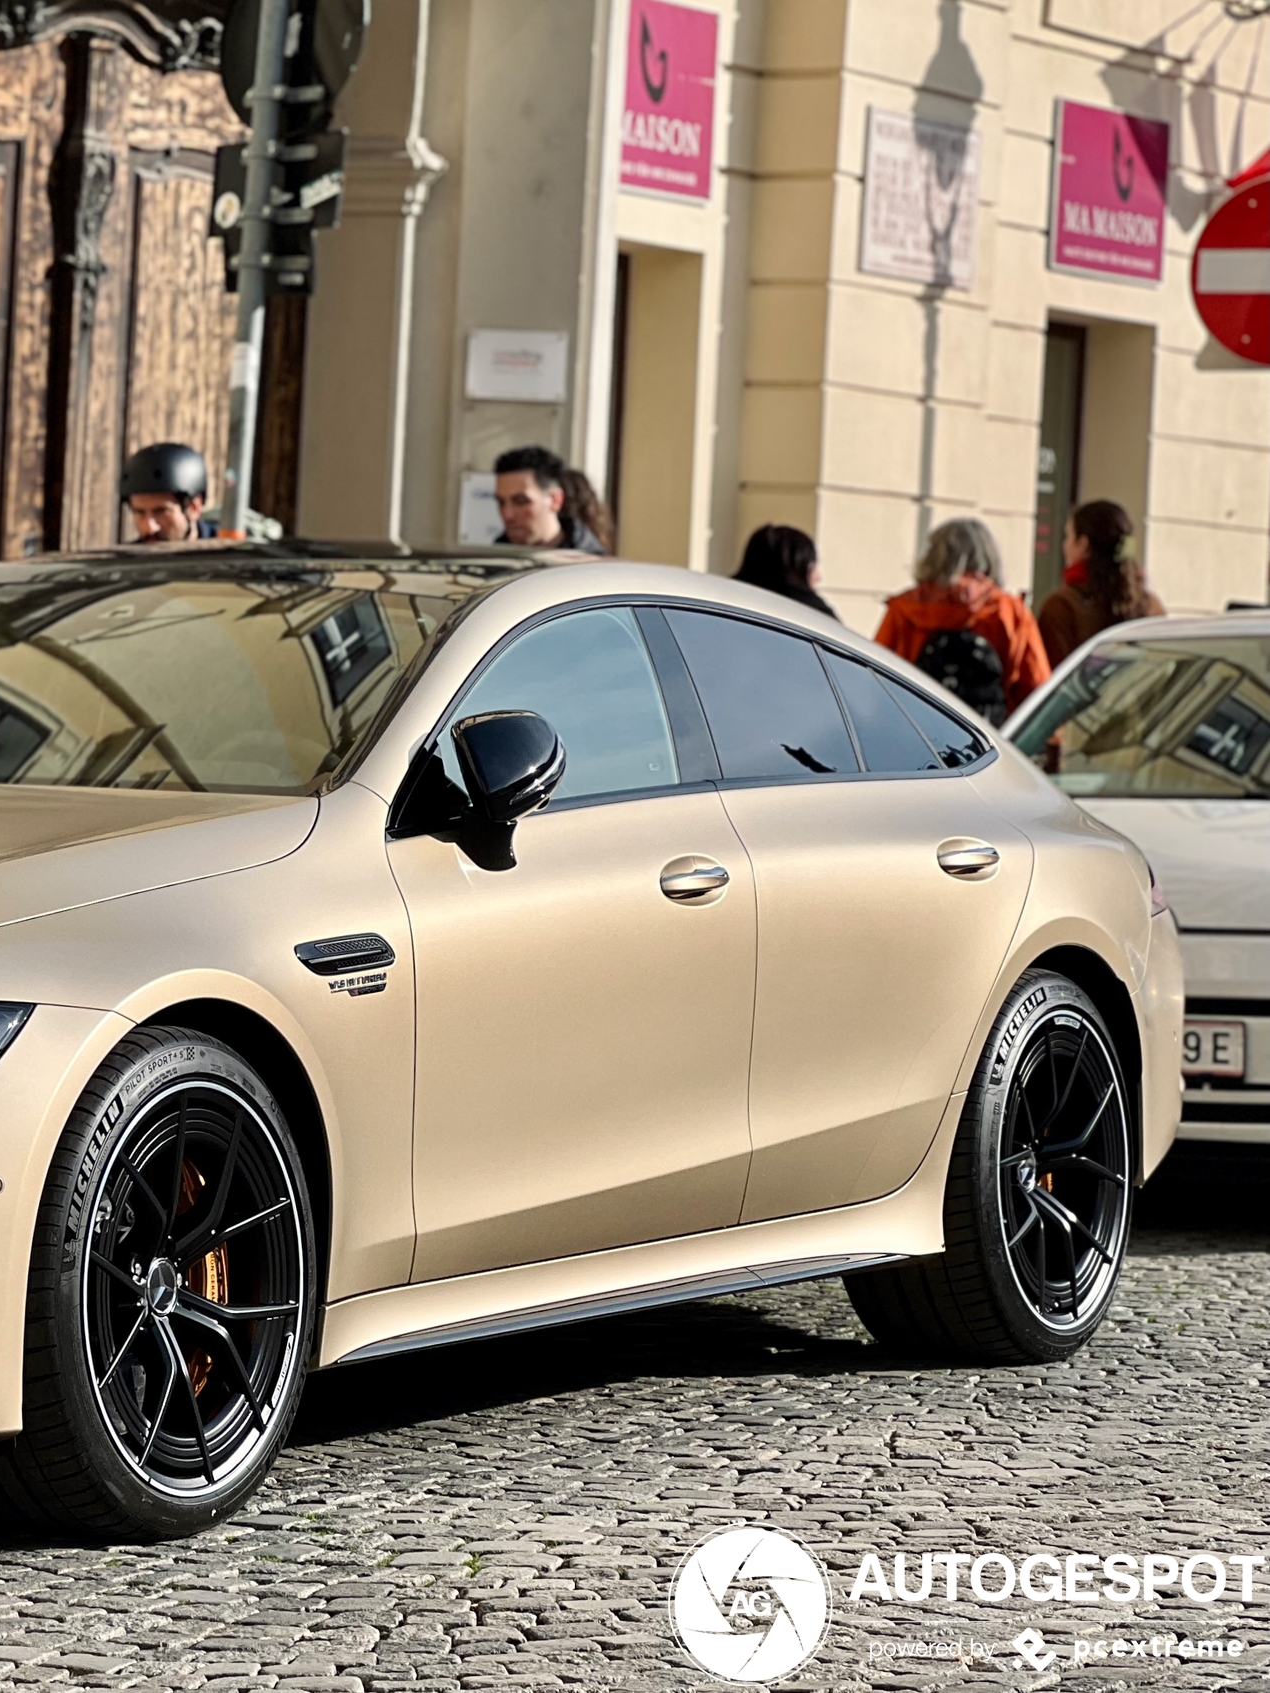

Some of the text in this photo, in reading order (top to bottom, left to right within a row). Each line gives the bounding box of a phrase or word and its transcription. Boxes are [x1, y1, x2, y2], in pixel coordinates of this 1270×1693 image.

[1063, 200, 1158, 246] MA MAISON
[999, 988, 1045, 1061] MICHELIN
[125, 1070, 146, 1094] PILOT
[67, 1100, 121, 1232] MICHELIN
